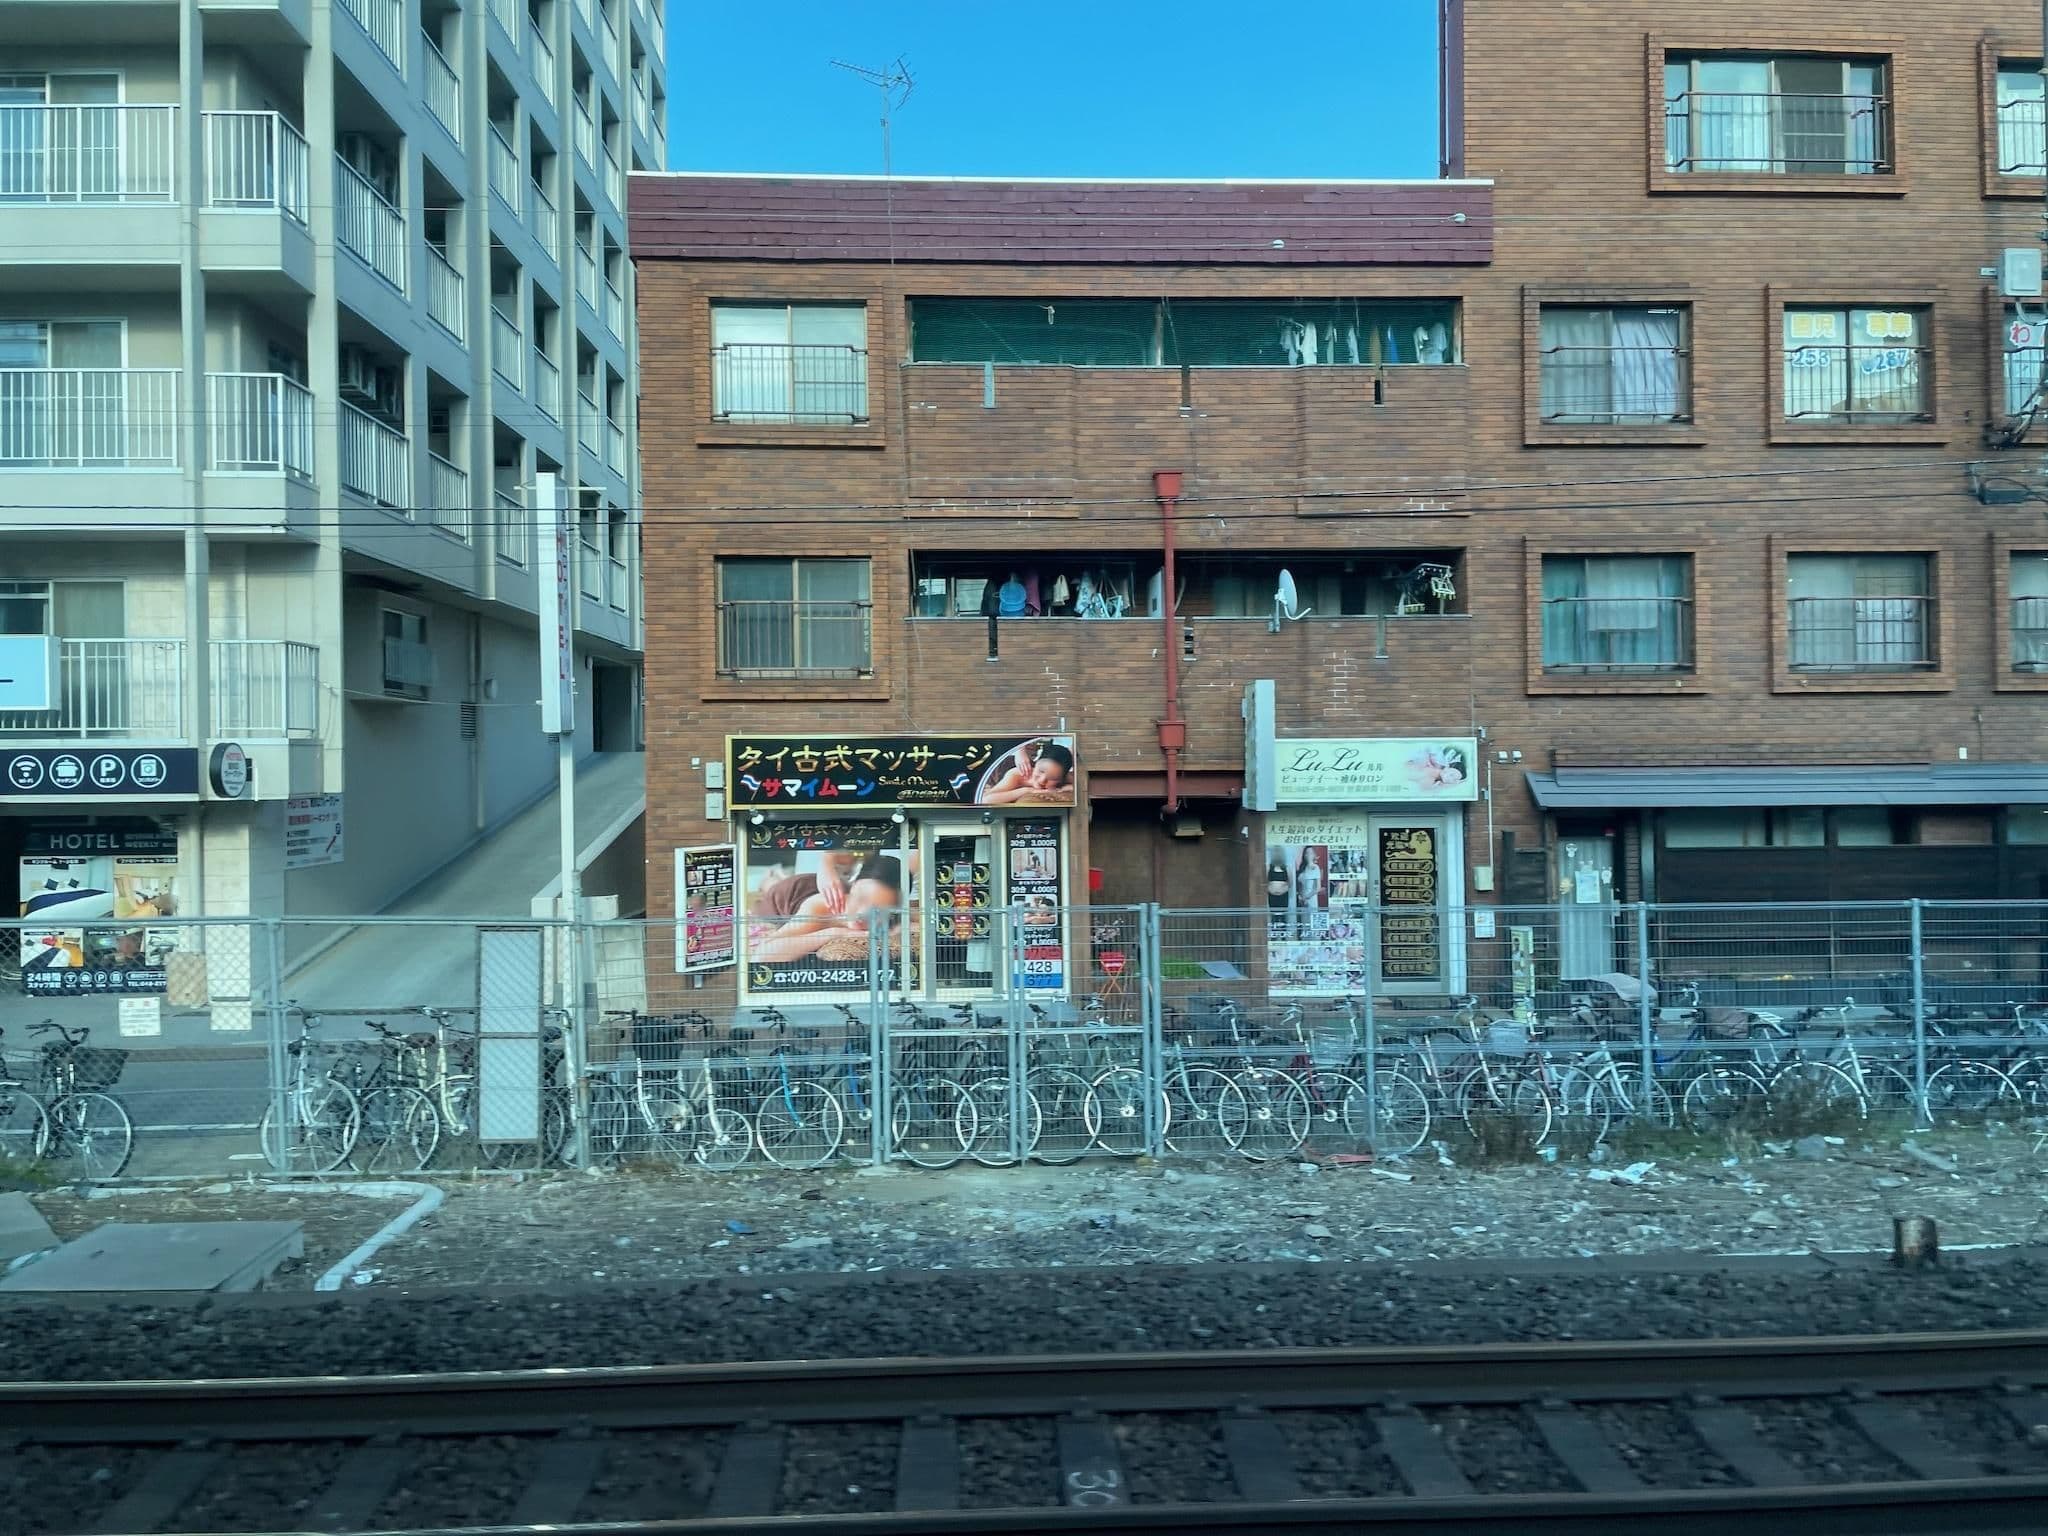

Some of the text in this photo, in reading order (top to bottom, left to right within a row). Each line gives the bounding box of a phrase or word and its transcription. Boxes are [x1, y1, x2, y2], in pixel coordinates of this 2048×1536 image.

[737, 745, 992, 773] タイ古式マッサージ
[763, 778, 875, 798] サマイムーン
[51, 834, 120, 849] HOTEL
[1023, 961, 1053, 973] 428
